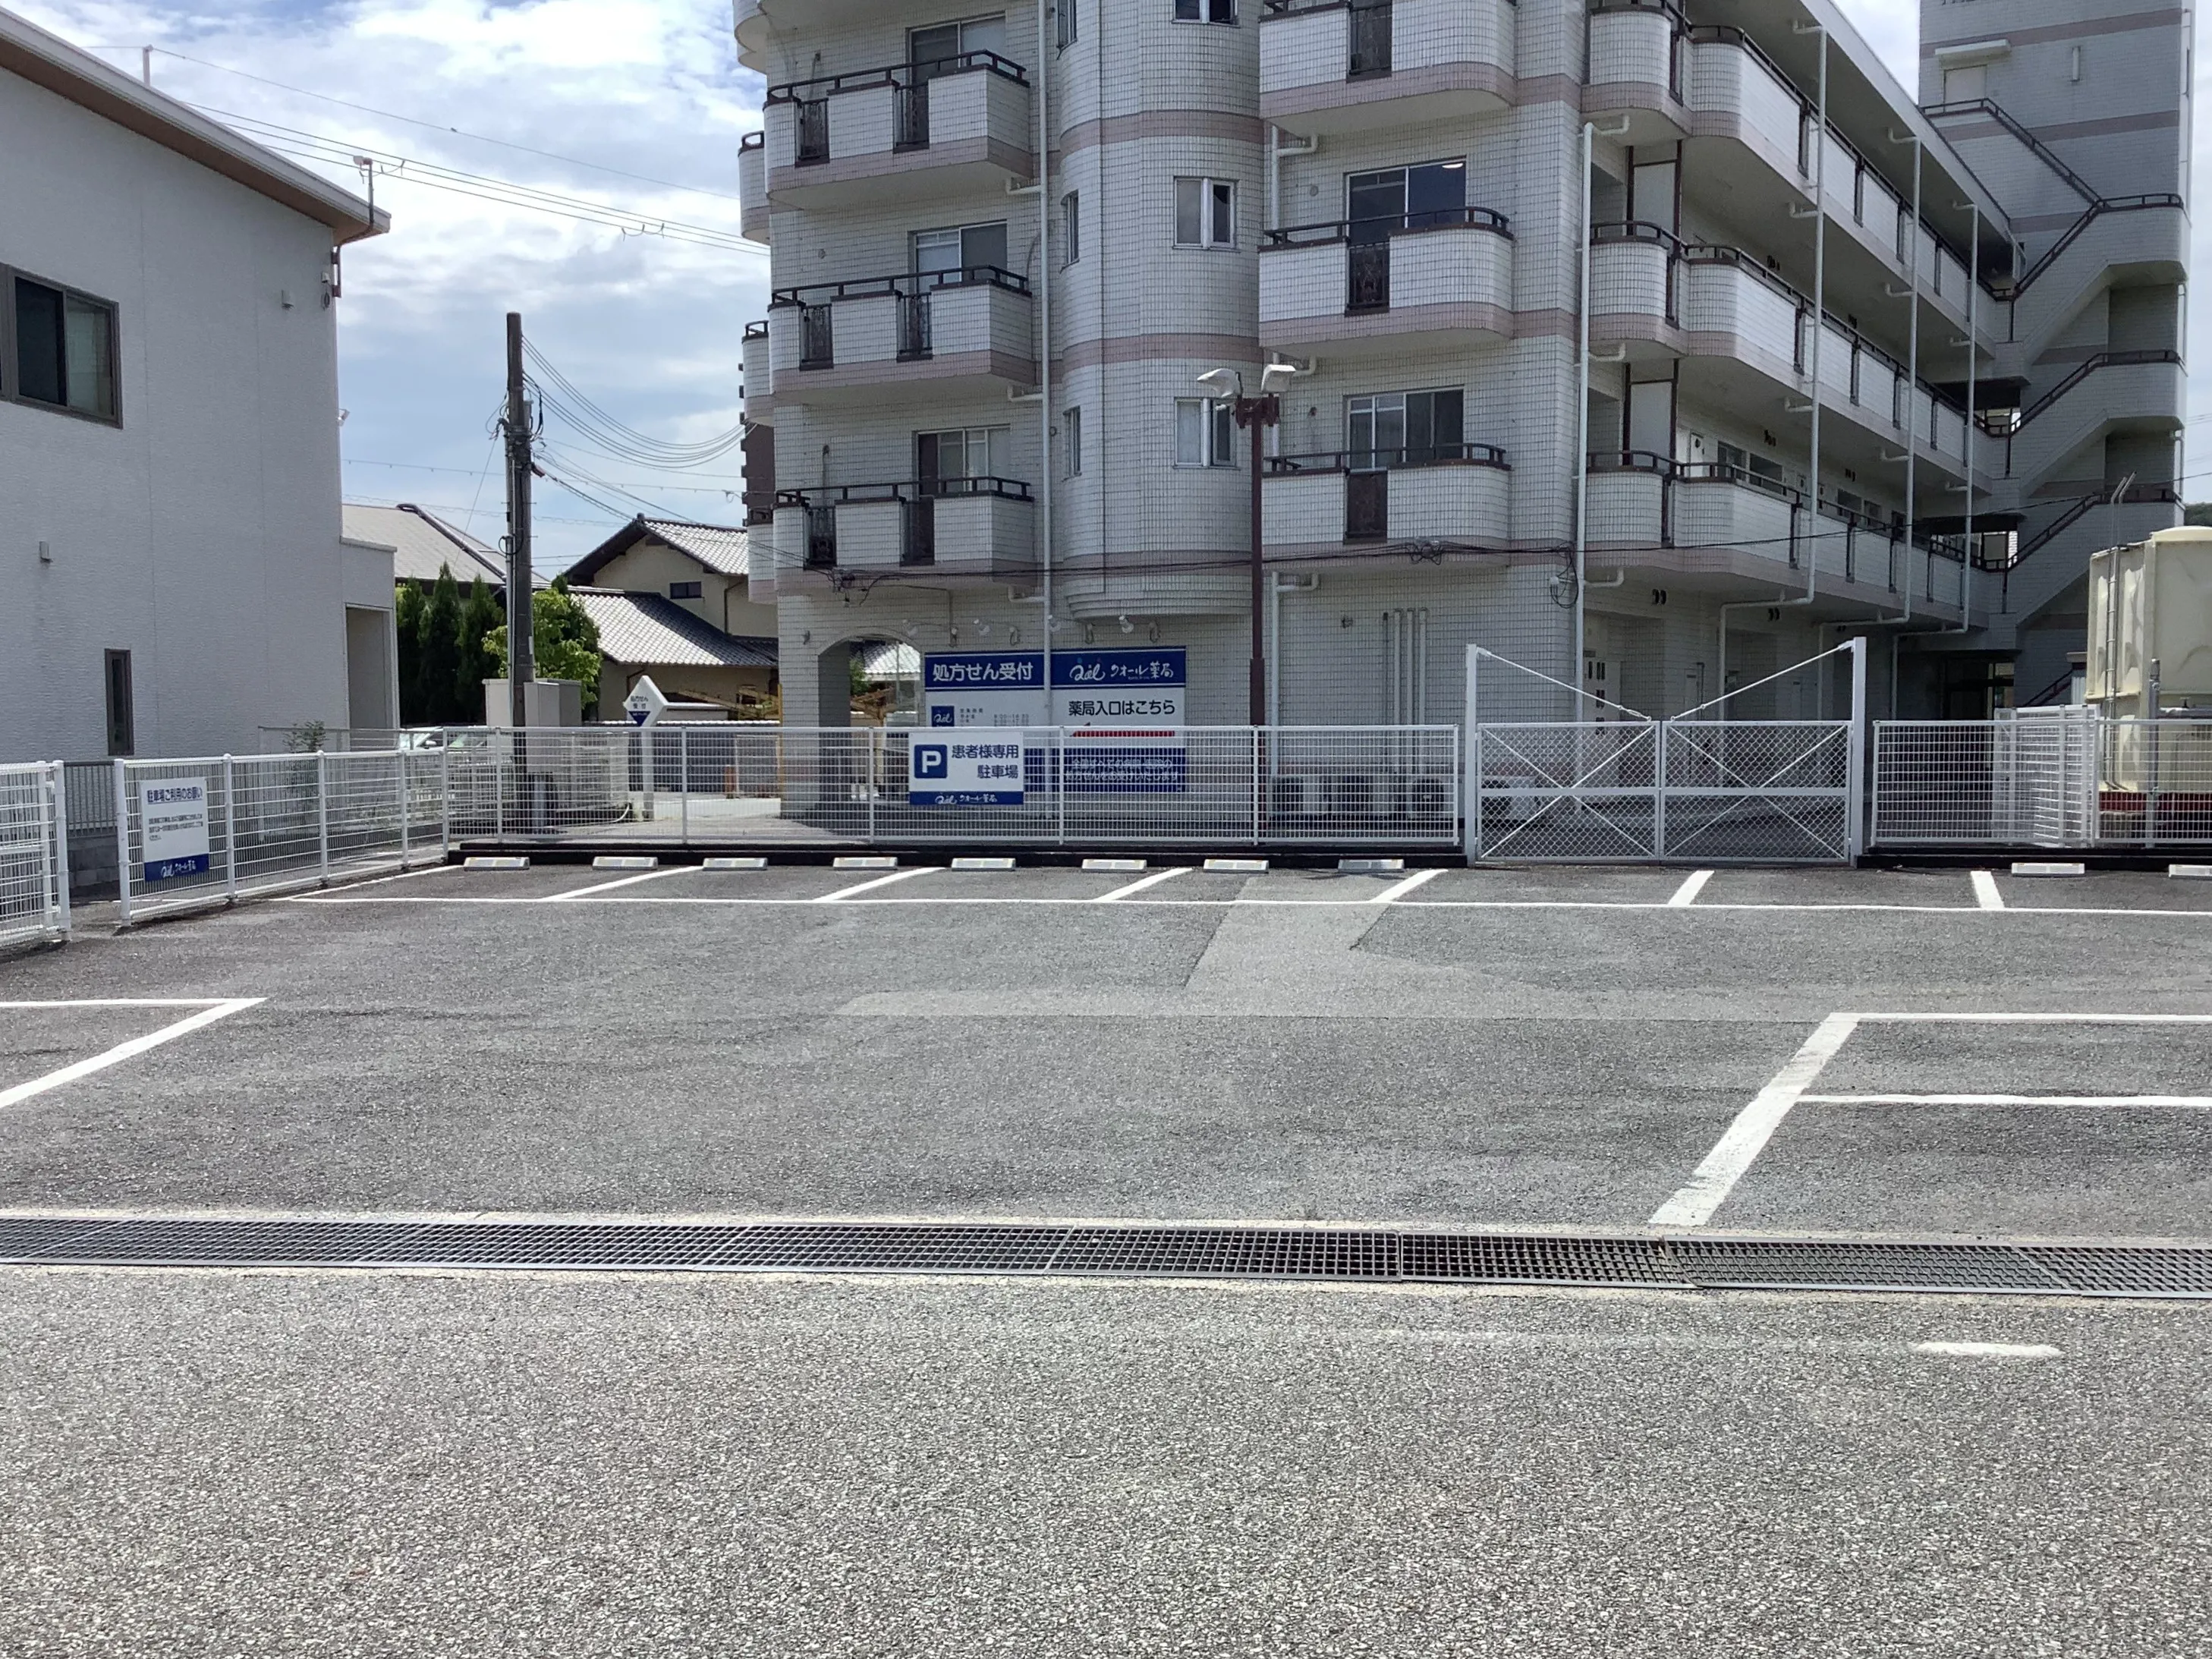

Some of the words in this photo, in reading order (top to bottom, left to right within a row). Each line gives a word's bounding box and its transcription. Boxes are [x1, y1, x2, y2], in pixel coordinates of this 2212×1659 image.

[933, 662, 1033, 682] 処方せん受付
[1110, 660, 1174, 679] クオール薬局
[1068, 700, 1175, 716] 薬局入口はこちら
[952, 744, 1019, 759] 患者様専用
[922, 750, 942, 773] P
[977, 764, 1018, 779] 駐車場
